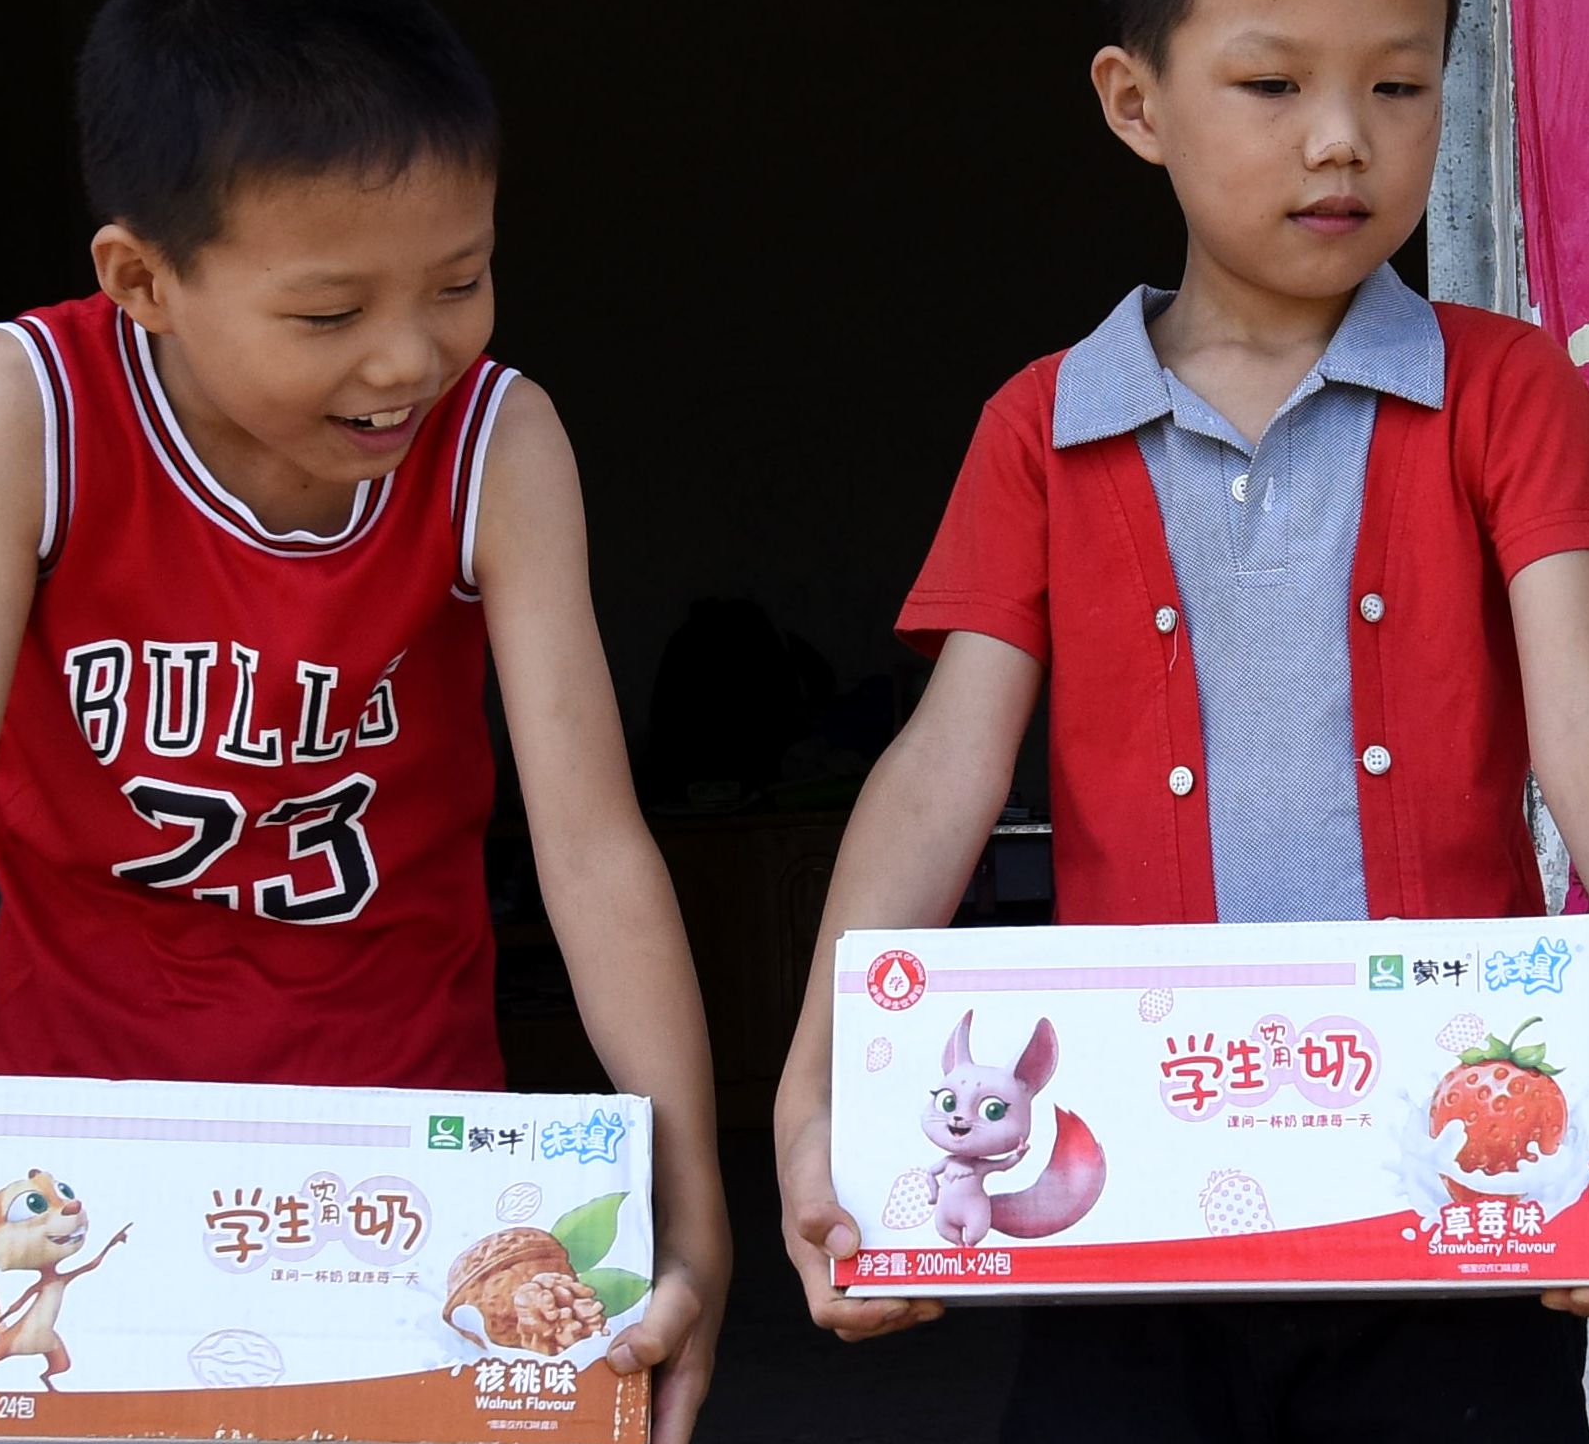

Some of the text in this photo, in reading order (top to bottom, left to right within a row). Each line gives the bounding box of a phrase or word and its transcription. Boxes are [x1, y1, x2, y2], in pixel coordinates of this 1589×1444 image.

[64, 638, 408, 767] BULLS
[111, 772, 379, 926] 23
[1412, 959, 1469, 988] 蒙牛
[1484, 937, 1572, 994] 未来星
[468, 1127, 525, 1155] 蒙牛
[541, 1109, 626, 1164] 未来星
[1444, 1201, 1543, 1241] 草莓味
[1428, 1240, 1556, 1257] Strawberry Flavour
[474, 1362, 577, 1395] 核桃味
[475, 1395, 576, 1411] Walnut Flavour
